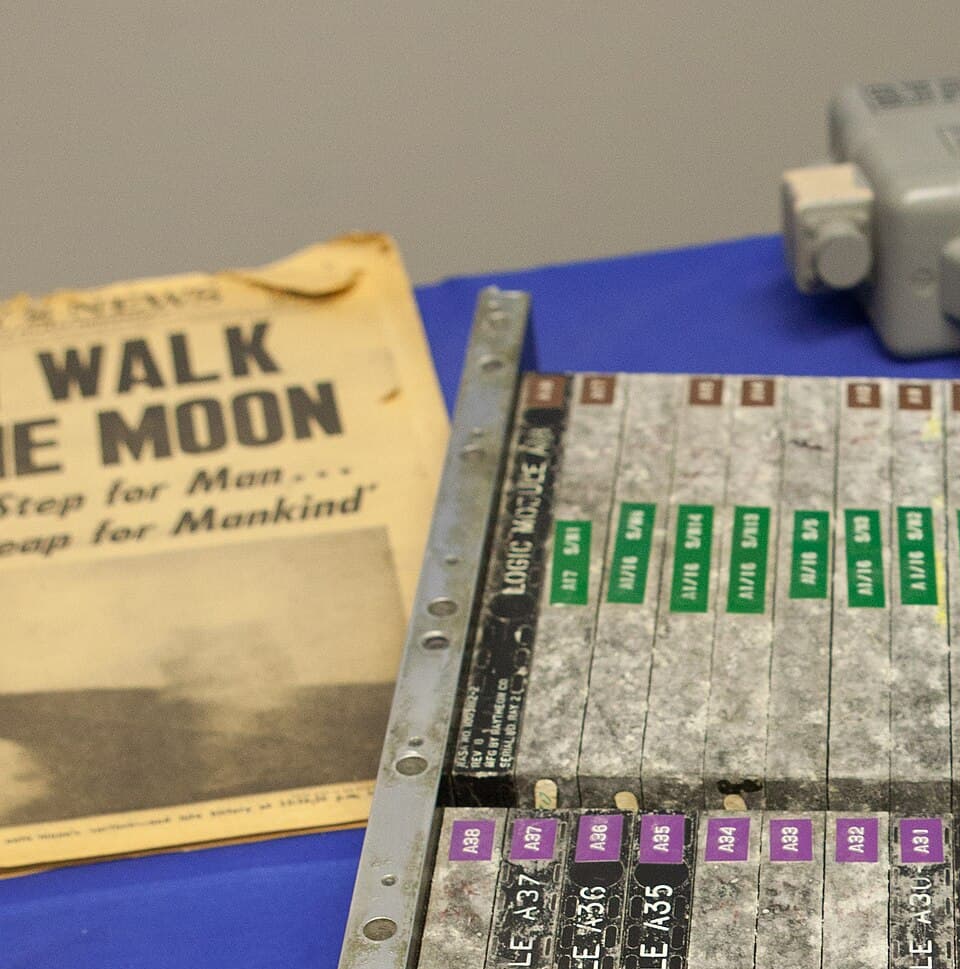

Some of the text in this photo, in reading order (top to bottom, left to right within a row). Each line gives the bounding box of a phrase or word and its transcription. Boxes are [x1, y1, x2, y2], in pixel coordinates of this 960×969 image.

[37, 321, 281, 402] WALK
[98, 381, 343, 467] MOON
[106, 479, 166, 507] for
[93, 519, 153, 547] for
[502, 541, 534, 594] LOGIC
[462, 827, 481, 854] A38
[524, 824, 542, 851] A37
[590, 824, 609, 851] A36
[654, 825, 671, 852] A35
[717, 826, 736, 853] A34
[782, 826, 799, 852] A33
[848, 826, 866, 853] A32
[912, 828, 930, 854] A31
[513, 873, 541, 921] A37
[579, 886, 607, 933] A36
[642, 884, 673, 932] A35
